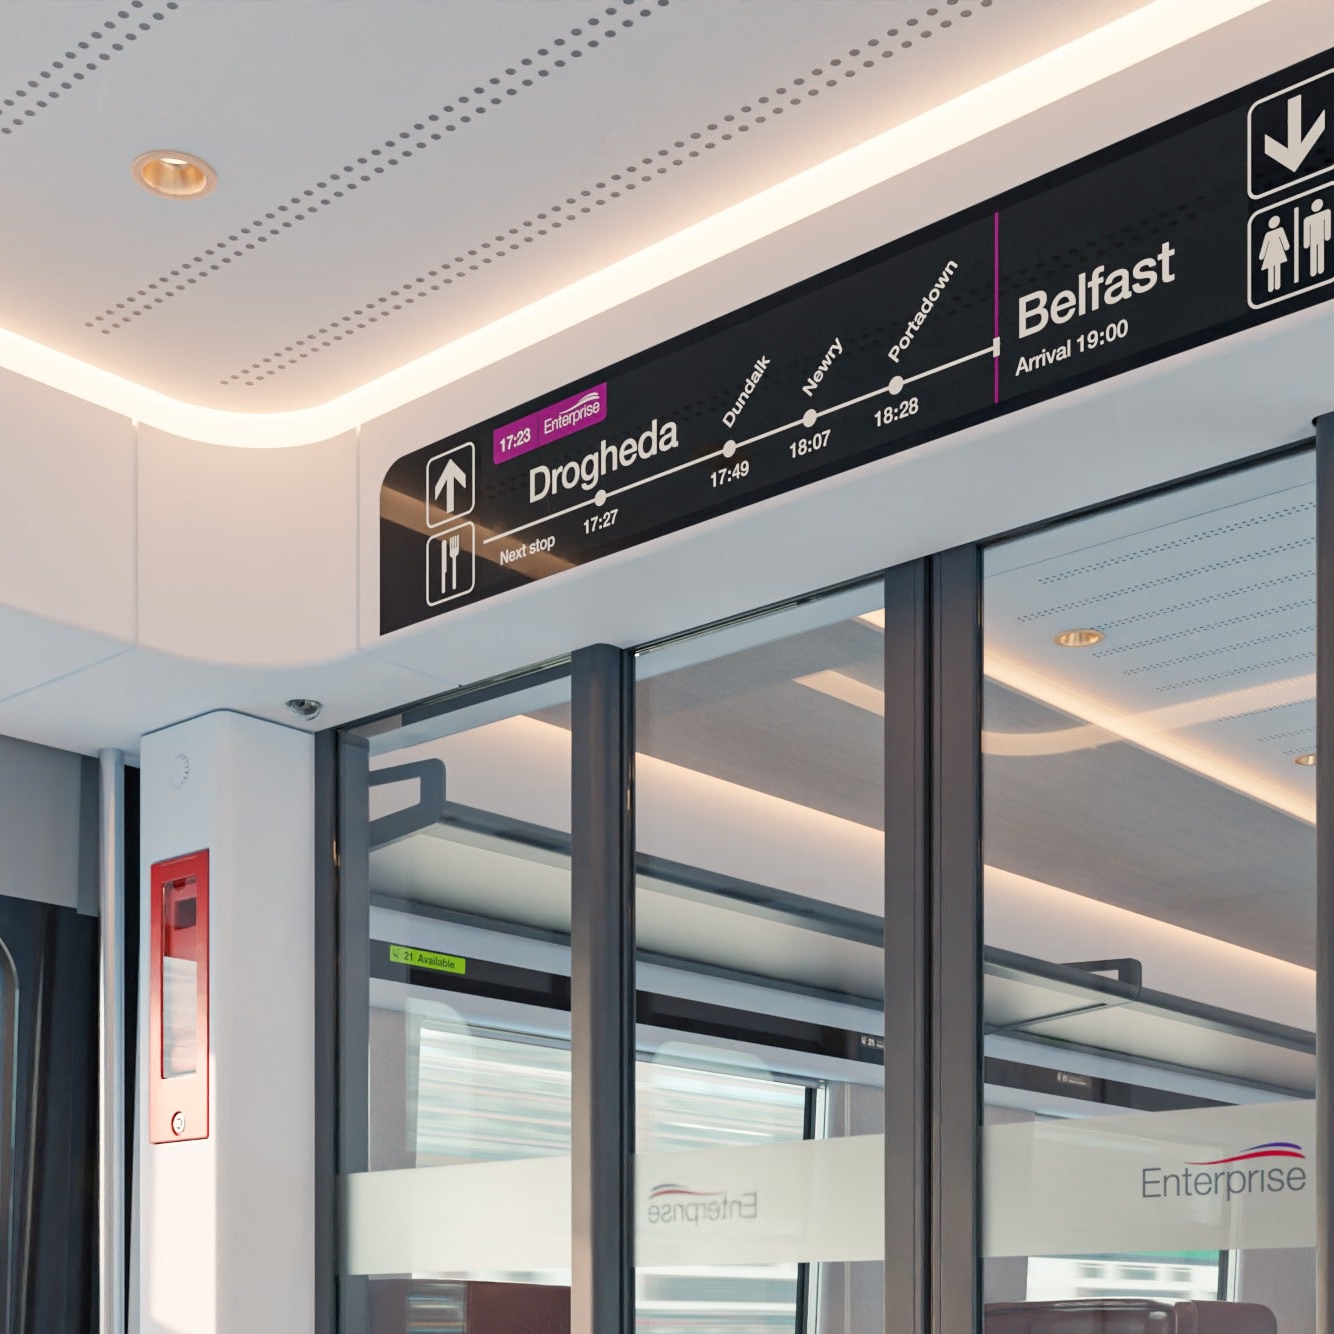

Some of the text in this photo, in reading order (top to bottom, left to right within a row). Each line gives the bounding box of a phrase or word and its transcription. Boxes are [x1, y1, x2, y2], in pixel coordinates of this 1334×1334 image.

[887, 260, 958, 363] Portadown
[1019, 241, 1176, 339] Belfast
[802, 337, 844, 397] Newry
[1015, 319, 1129, 376] Arrival 19:00
[722, 355, 771, 428] Dundalk
[874, 397, 919, 427] 18:28
[500, 400, 601, 453] 17:23 Enterprise
[789, 429, 831, 459] 18:07
[529, 419, 679, 503] Drogheda
[710, 460, 750, 488] 17:49
[583, 508, 619, 534] 17:27
[500, 535, 556, 566] Next stop
[417, 954, 456, 969] Available
[1142, 1166, 1307, 1202] Enterprise
